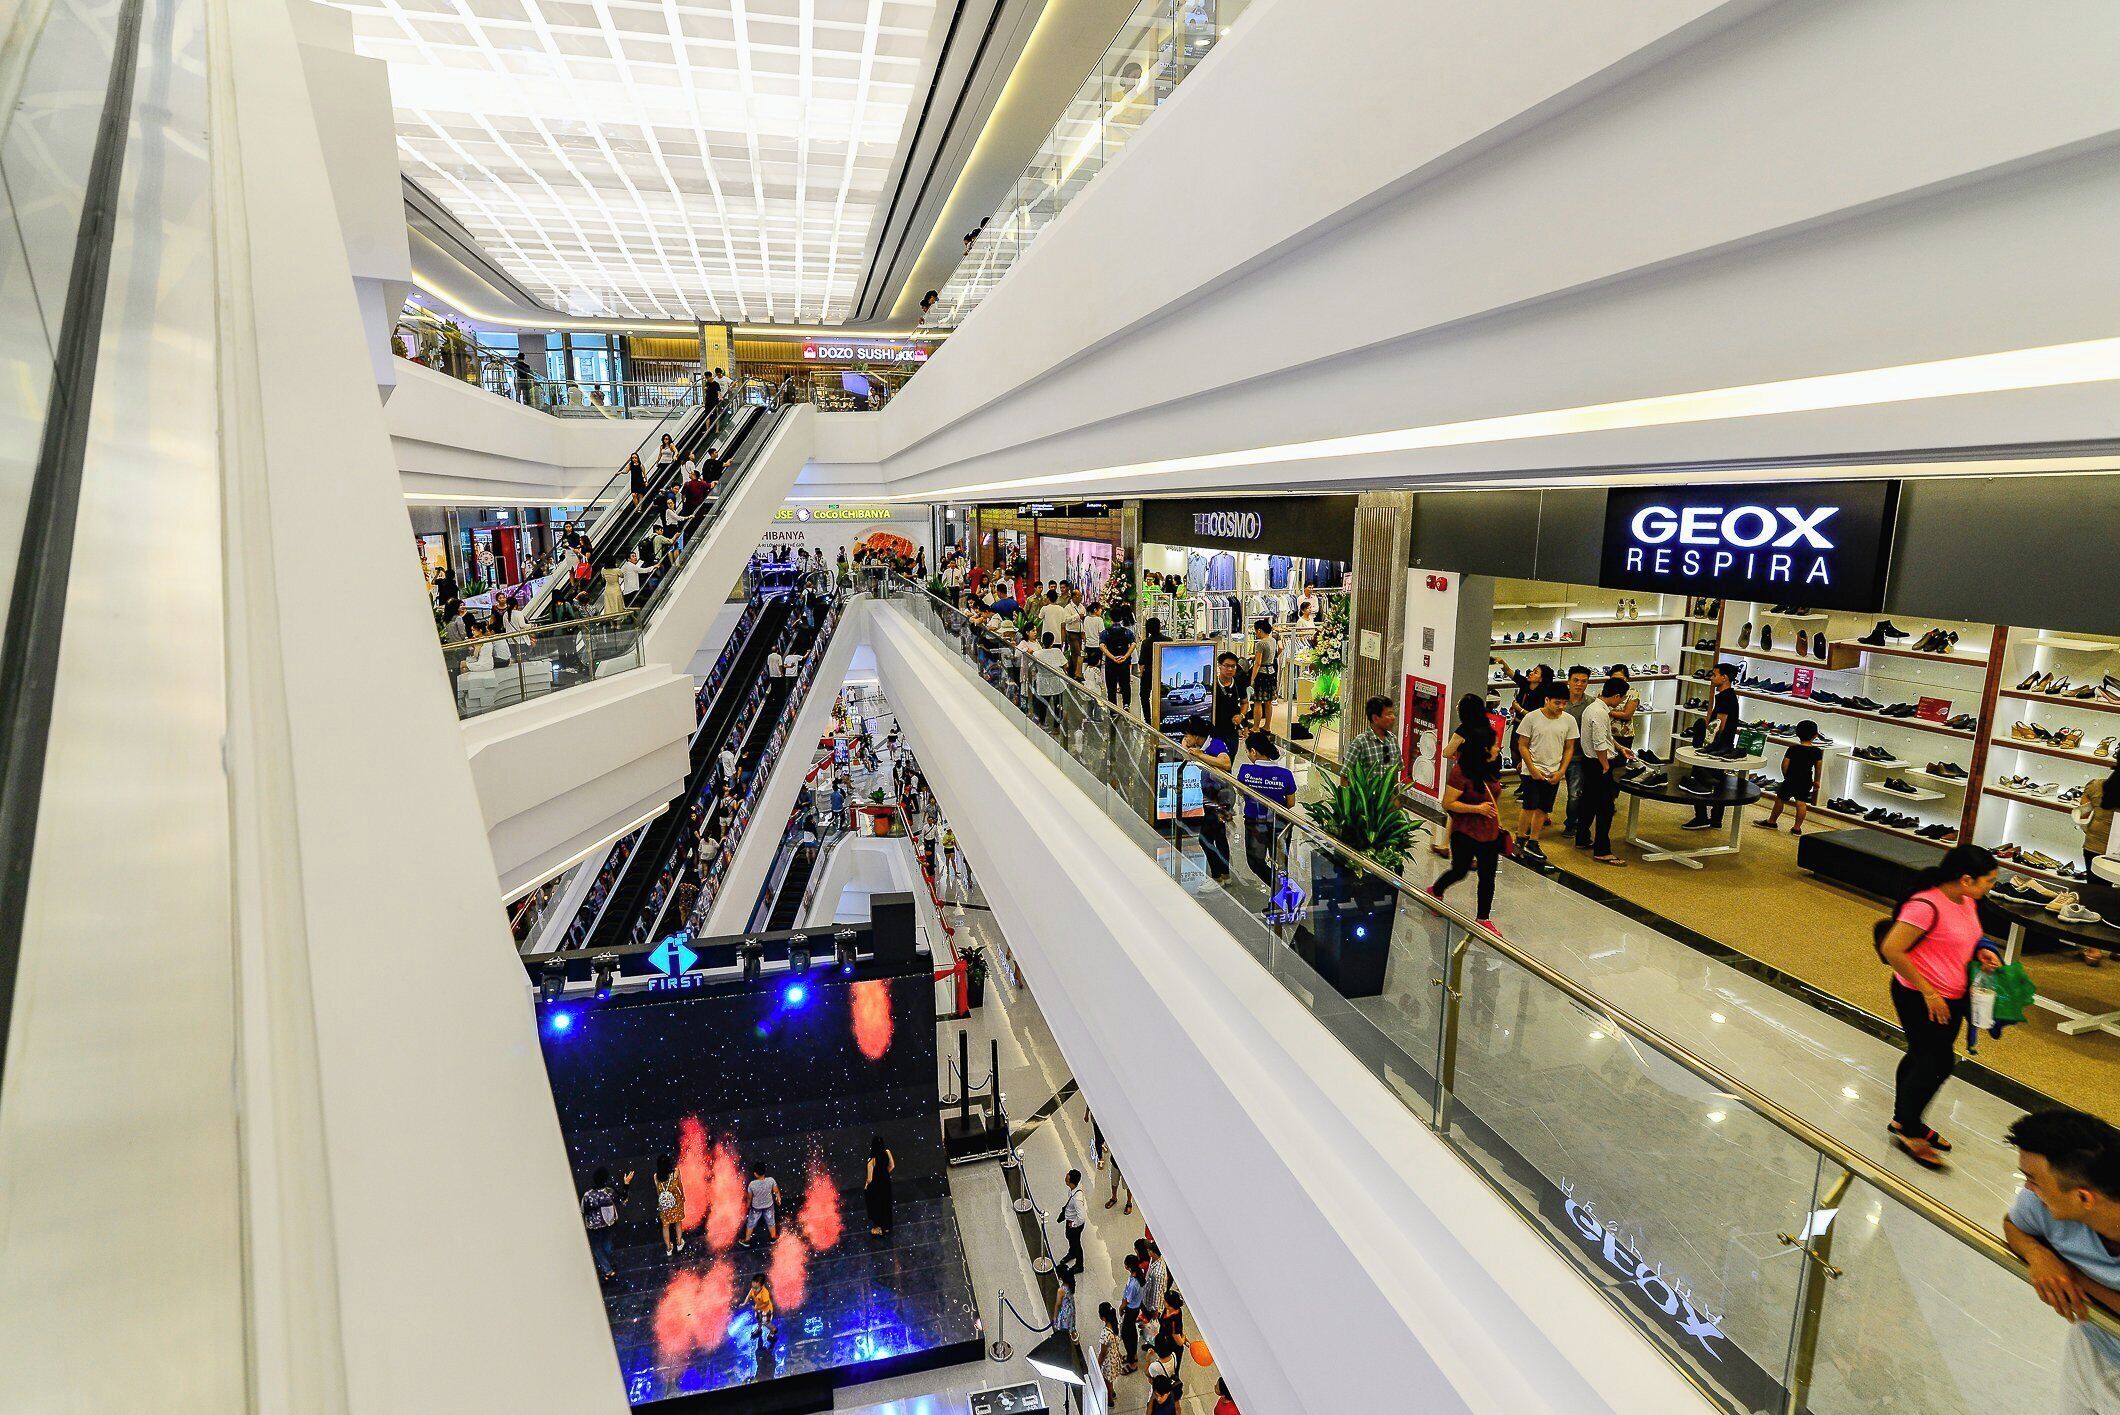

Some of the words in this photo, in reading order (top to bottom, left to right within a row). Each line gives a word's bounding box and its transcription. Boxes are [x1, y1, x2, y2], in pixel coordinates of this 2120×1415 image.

[818, 346, 854, 359] DOZO
[857, 348, 895, 361] SUSHI
[838, 508, 892, 520] ICHIBANYA
[1631, 505, 1840, 549] GEOX
[1626, 547, 1830, 585] RESPIRA
[648, 975, 702, 990] FIRST
